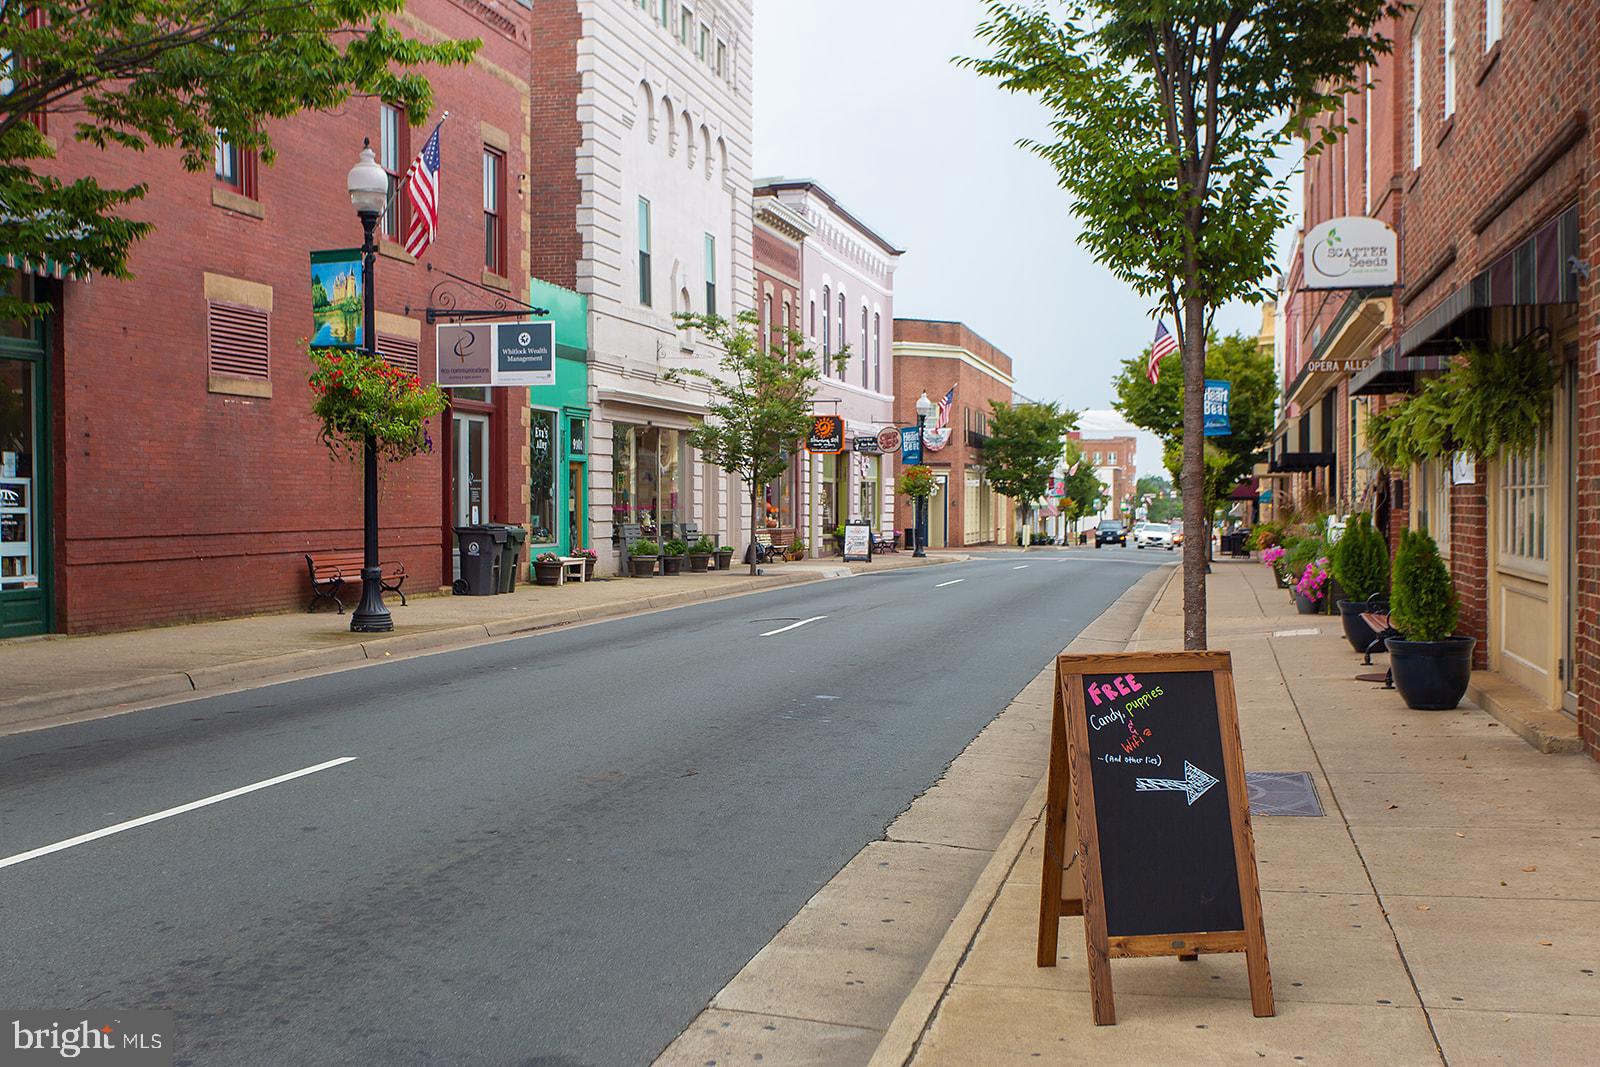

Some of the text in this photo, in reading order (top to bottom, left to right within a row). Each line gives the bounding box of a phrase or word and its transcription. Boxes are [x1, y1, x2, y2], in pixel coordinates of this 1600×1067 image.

[1328, 247, 1388, 258] SCATTER
[1349, 257, 1388, 267] Seeds
[507, 355, 543, 363] Management
[1308, 360, 1371, 371] OPERA ALLE
[1203, 401, 1227, 416] Beat
[1088, 674, 1143, 706] FREE
[1090, 686, 1165, 731] Candy, puppies
